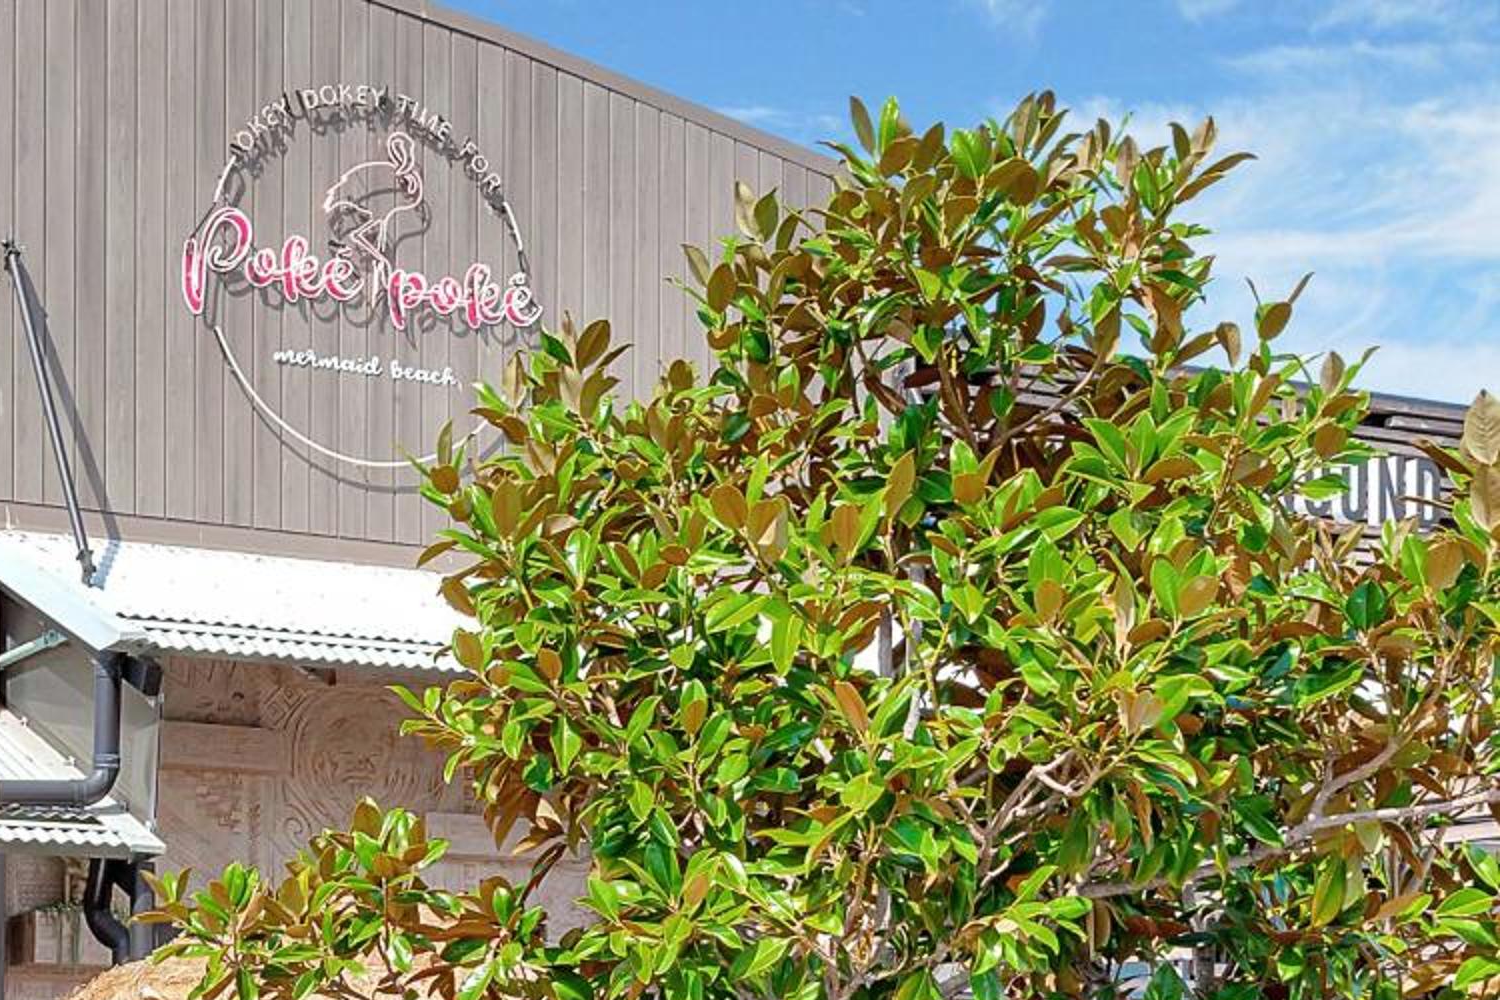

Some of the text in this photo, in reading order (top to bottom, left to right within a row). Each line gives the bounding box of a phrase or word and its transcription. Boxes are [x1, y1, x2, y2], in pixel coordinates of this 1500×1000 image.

[303, 85, 386, 109] DOKEY
[398, 94, 452, 142] TIME
[460, 140, 501, 192] FOR
[273, 350, 460, 386] mermaid beach
